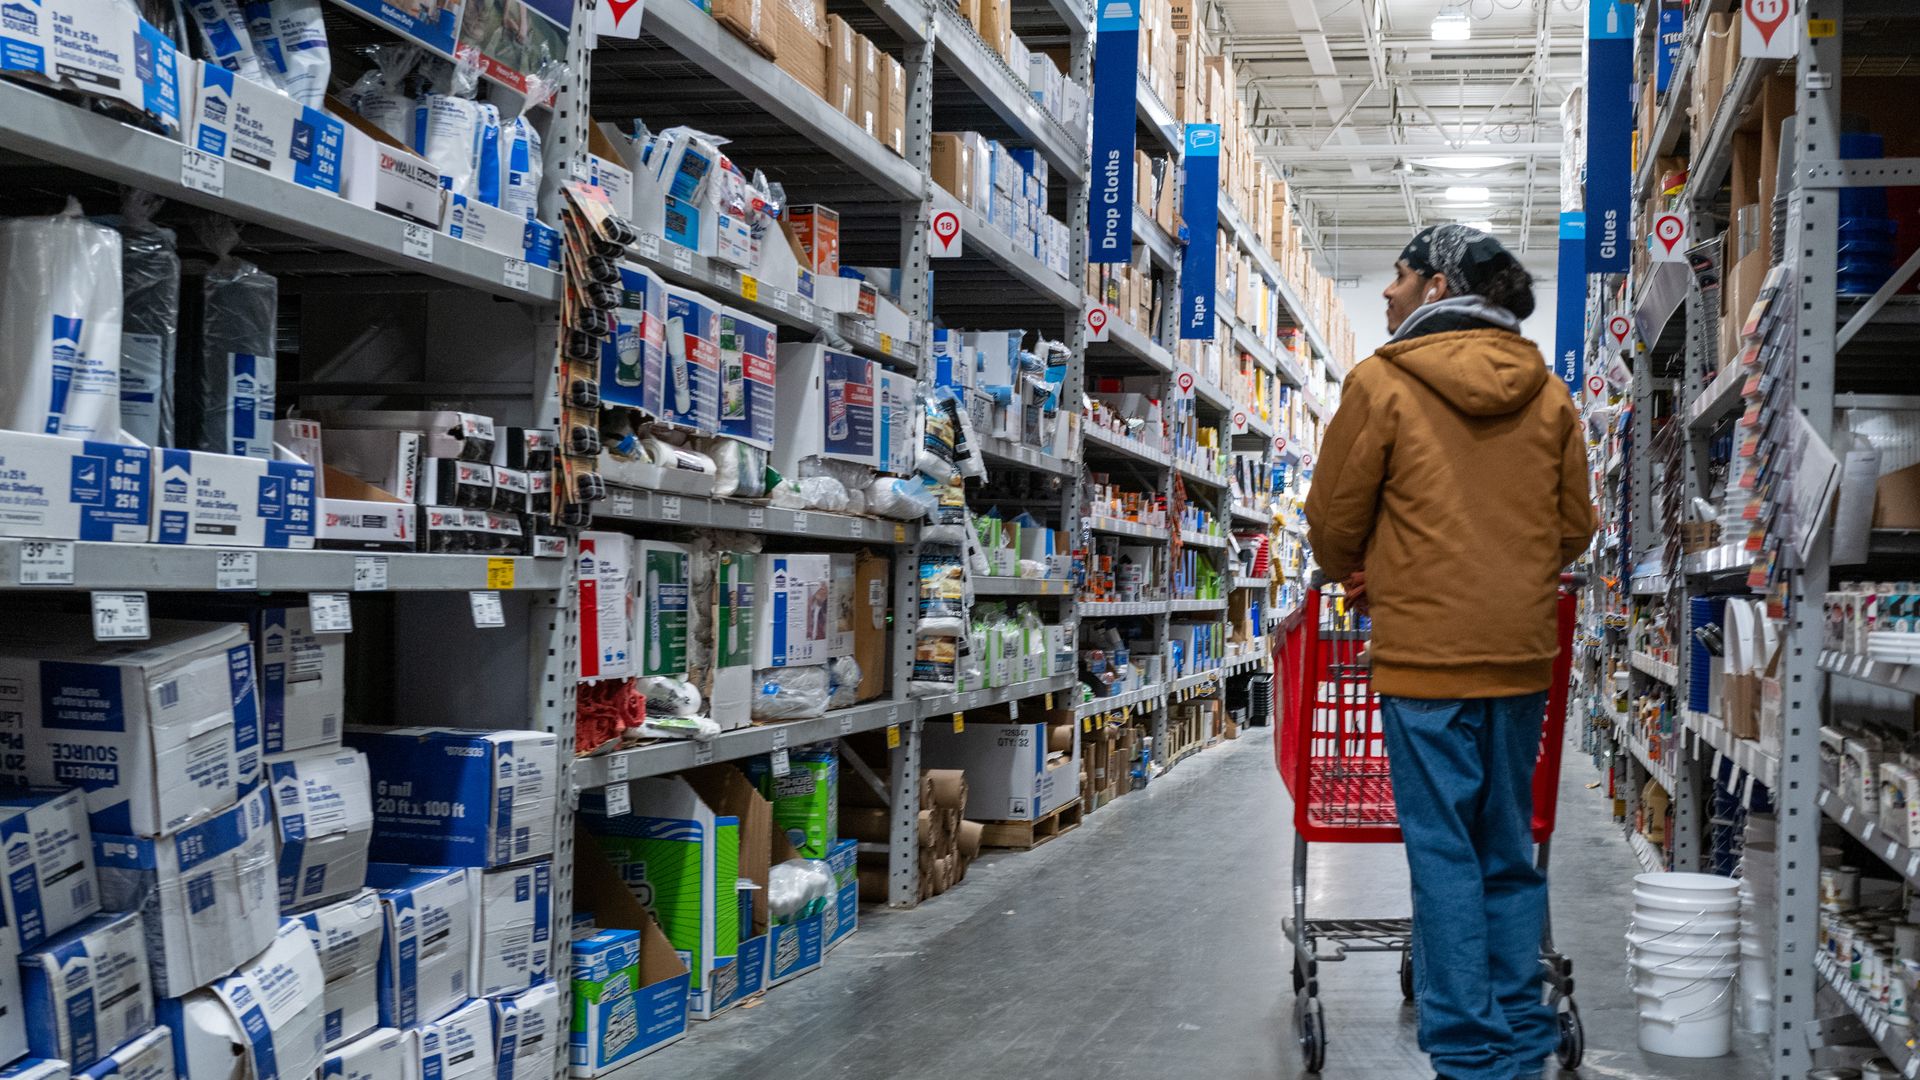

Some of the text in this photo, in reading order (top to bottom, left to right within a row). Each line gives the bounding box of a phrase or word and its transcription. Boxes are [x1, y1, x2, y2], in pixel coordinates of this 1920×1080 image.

[1757, 1, 1777, 14] 11
[2, 18, 39, 36] SOURCE
[60, 14, 73, 25] mil
[53, 24, 63, 34] 10
[80, 31, 91, 42] 25
[92, 33, 99, 44] ft
[54, 35, 119, 63] Plastic Sheeting
[326, 133, 338, 147] mil
[318, 160, 329, 173] 25
[1102, 149, 1121, 249] Drop Cloths
[940, 222, 952, 230] 18
[1600, 209, 1617, 259] Glues
[1665, 225, 1673, 235] 9
[1191, 295, 1207, 329] Tape
[1564, 350, 1576, 383] Caulk
[115, 459, 141, 475] 6 mil
[405, 437, 417, 497] ZIPWALL
[12, 483, 44, 496] Sheeting
[110, 476, 122, 491] 10
[291, 478, 310, 492] 6 mil
[115, 493, 141, 509] 25 ft
[291, 508, 309, 522] 25 ft
[997, 738, 1029, 748] QTY: 32
[53, 742, 118, 762] SOURCE
[59, 764, 116, 781] PROJECT
[377, 780, 412, 797] 6 mil
[376, 798, 465, 818] 20 ft x 100 ft
[103, 842, 138, 859] 6 mil
